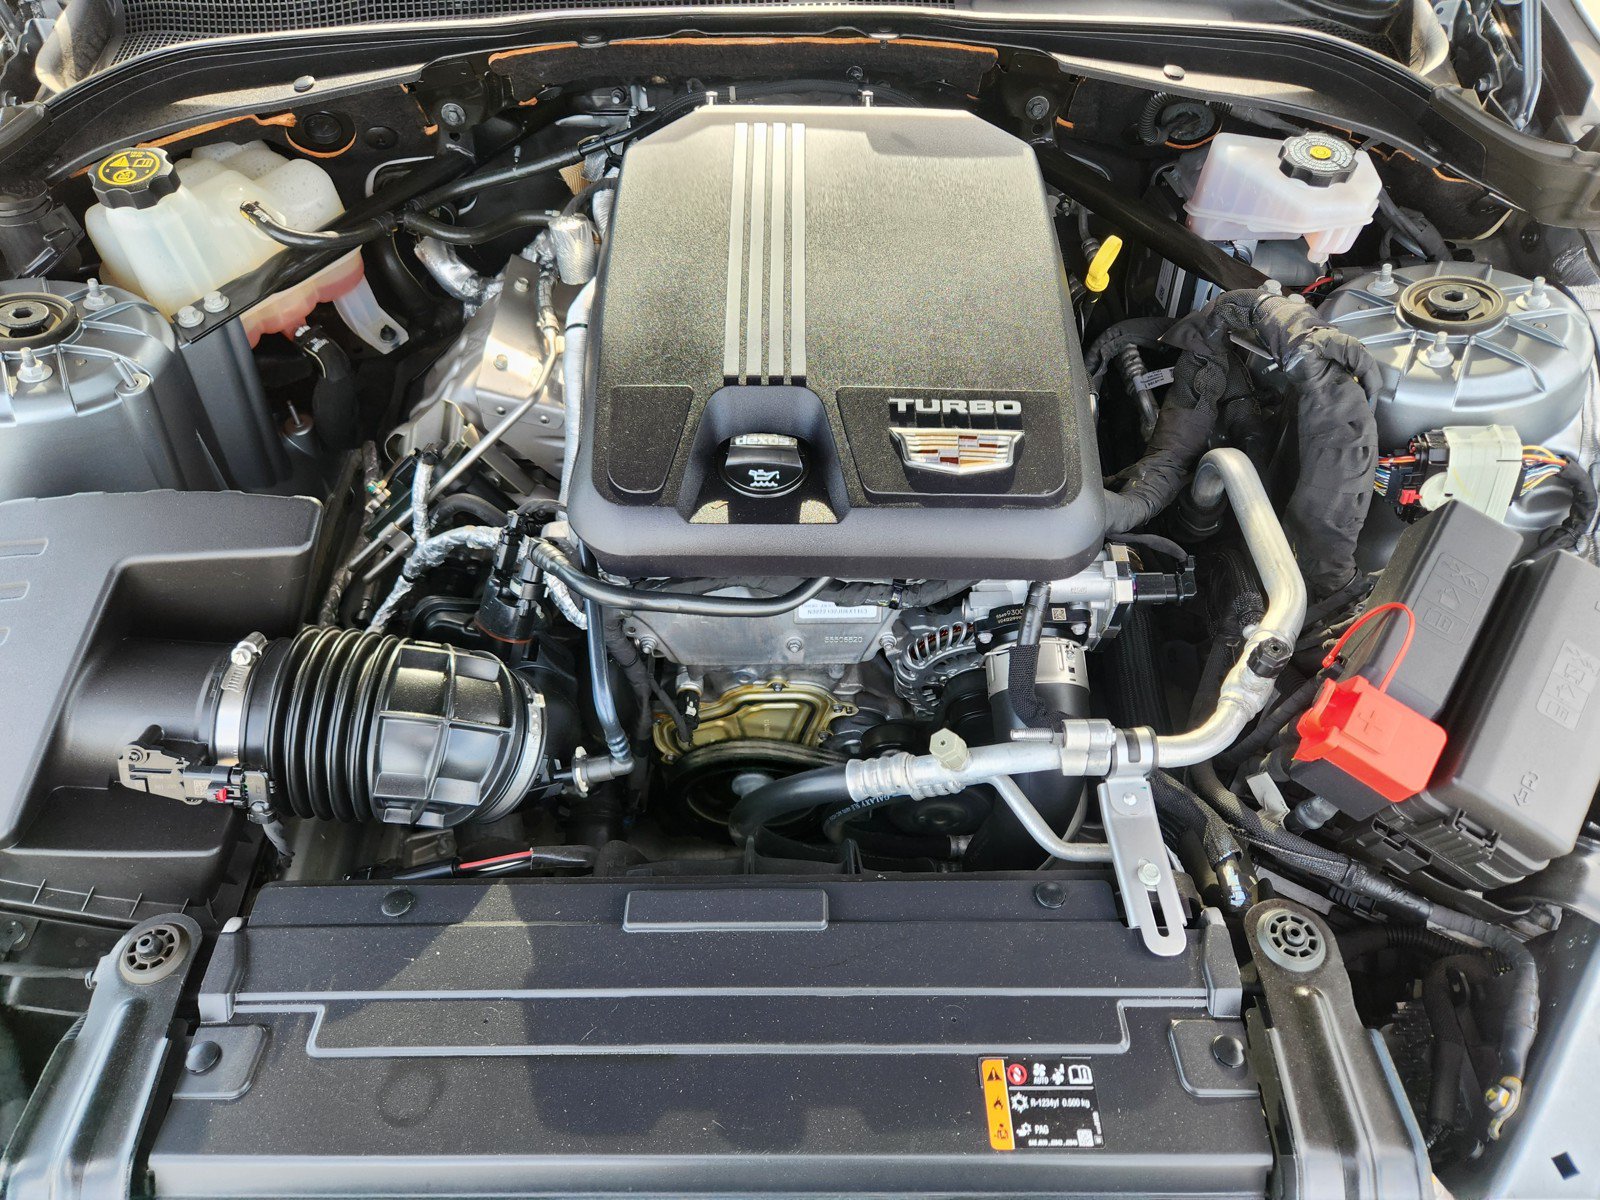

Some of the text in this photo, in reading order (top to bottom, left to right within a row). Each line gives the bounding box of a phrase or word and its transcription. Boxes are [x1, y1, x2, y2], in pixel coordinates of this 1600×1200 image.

[889, 398, 1022, 414] TURBO
[735, 434, 791, 446] dexos
[1033, 1076, 1049, 1085] AUTO
[1081, 1097, 1090, 1109] kg
[1034, 1124, 1050, 1135] PAG
